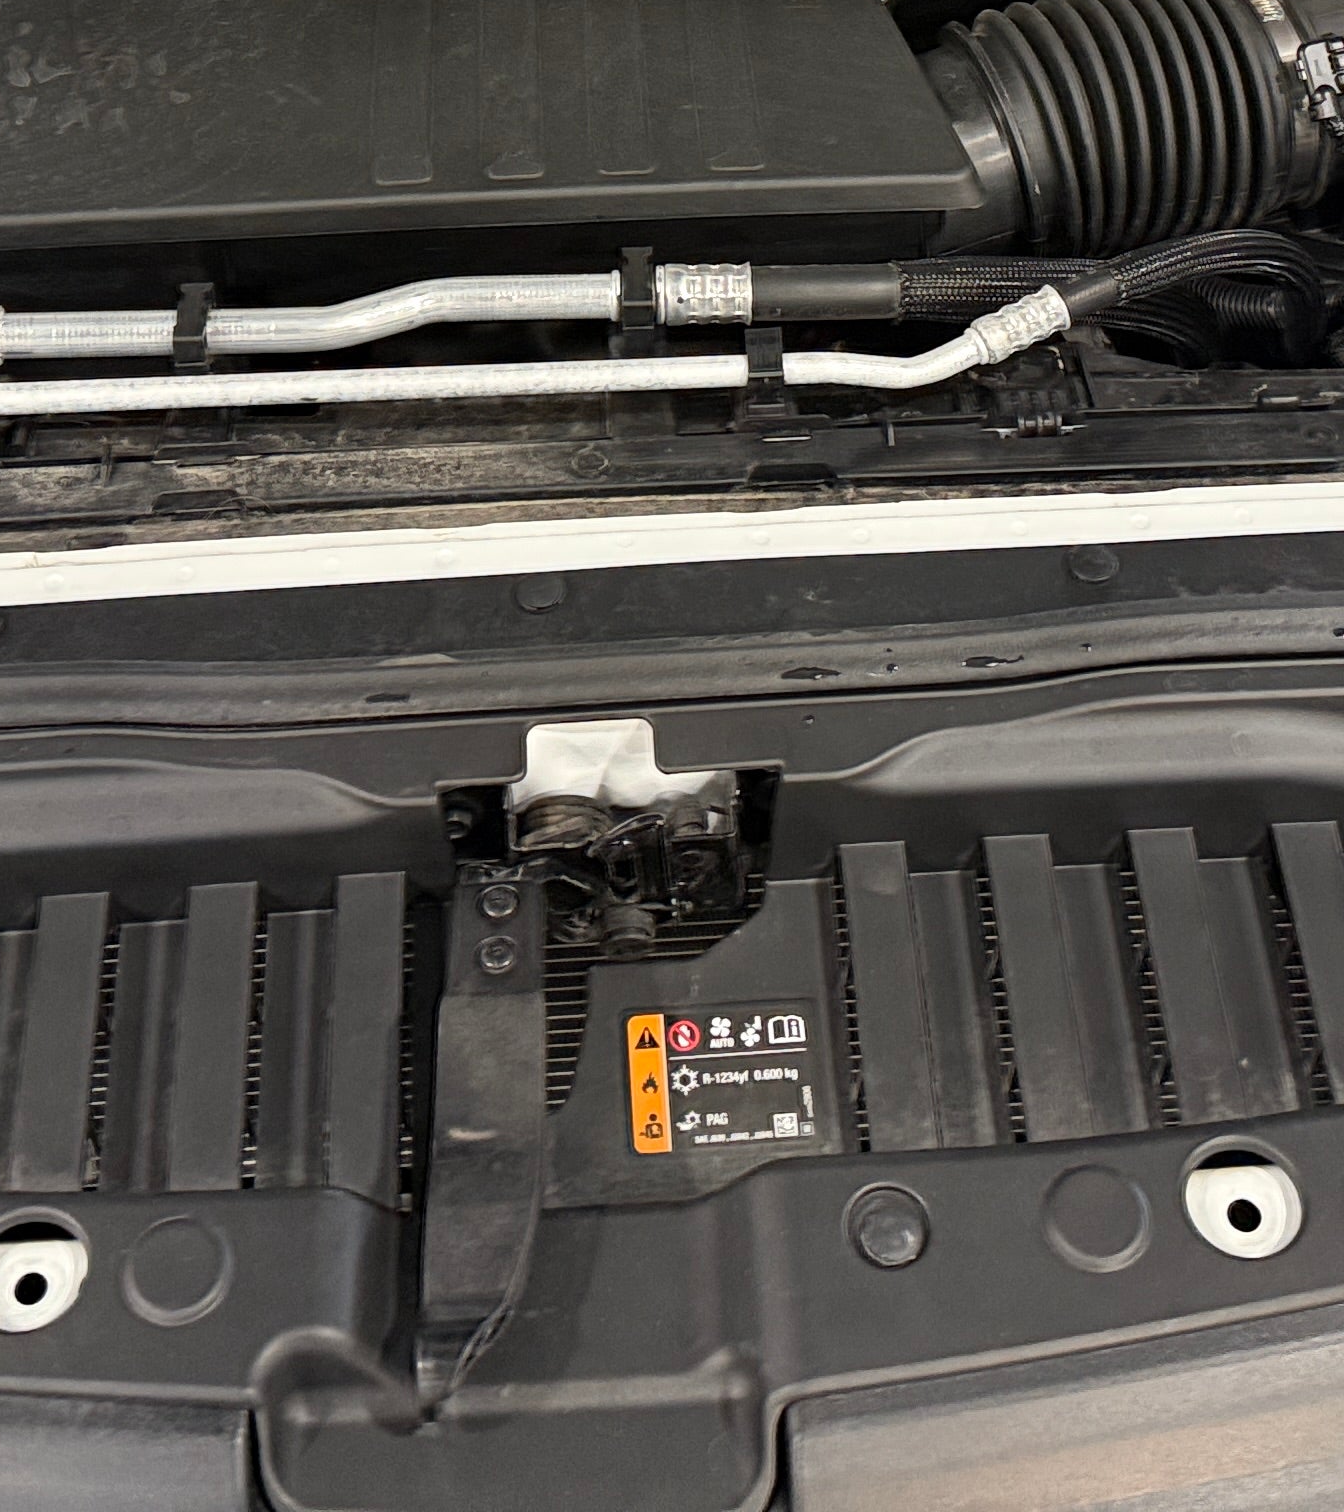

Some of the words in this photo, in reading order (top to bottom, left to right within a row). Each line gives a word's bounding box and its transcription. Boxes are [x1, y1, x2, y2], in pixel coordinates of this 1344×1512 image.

[709, 1037, 735, 1049] AUTO
[702, 1070, 749, 1085] R-1234yf
[753, 1068, 783, 1081] 0.600
[784, 1068, 799, 1081] kg
[706, 1112, 729, 1126] PAG
